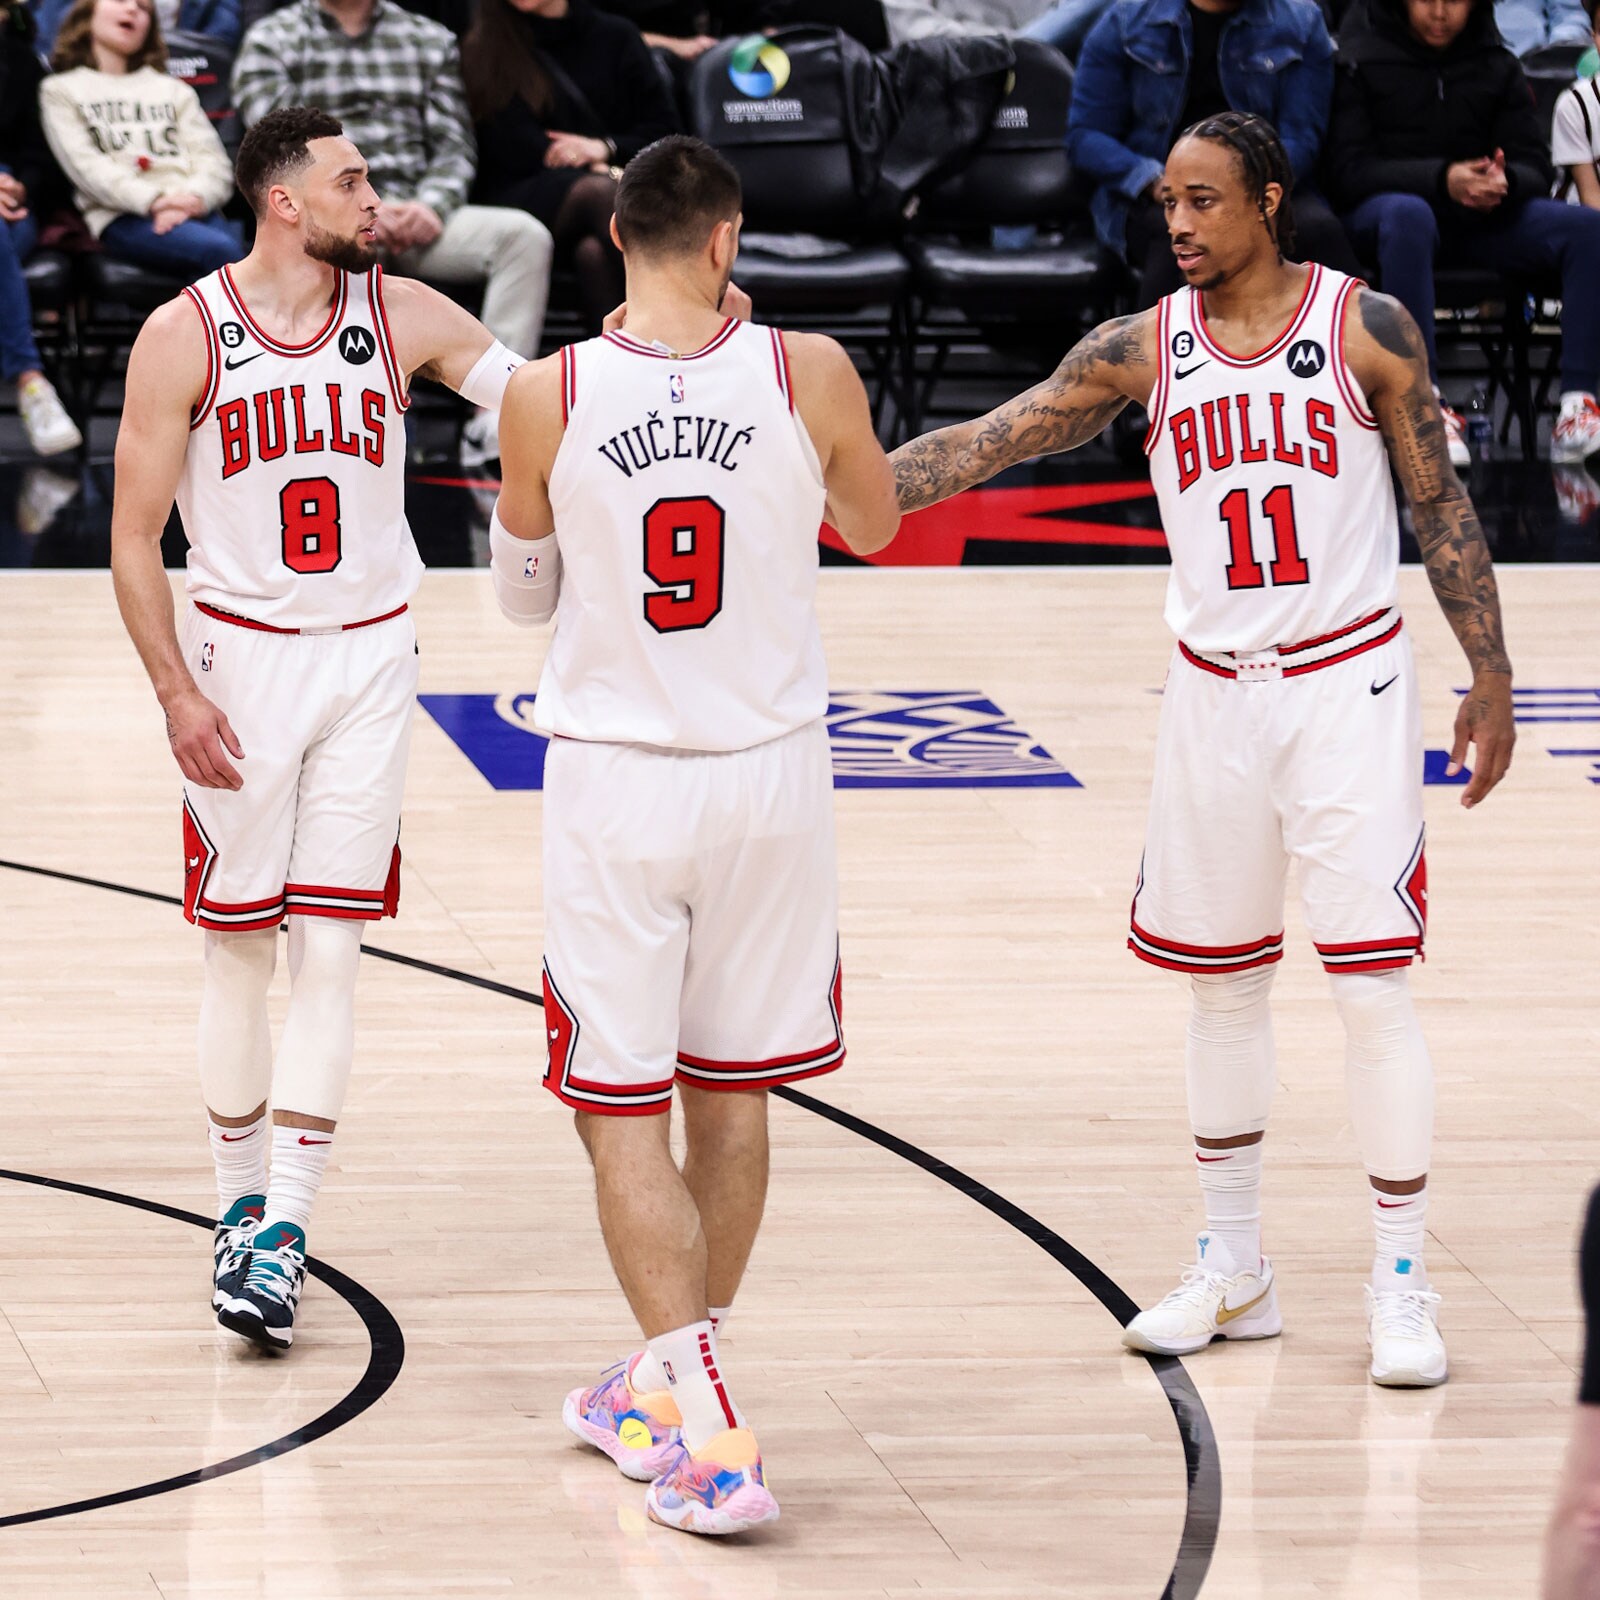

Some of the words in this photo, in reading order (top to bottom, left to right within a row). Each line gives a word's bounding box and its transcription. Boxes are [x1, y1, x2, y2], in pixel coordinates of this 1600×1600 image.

[216, 383, 386, 480] BULLS
[598, 410, 756, 478] VUČEVIĆ
[1169, 393, 1338, 494] BULLS
[279, 476, 342, 574] 8
[643, 495, 725, 634] 9
[1219, 484, 1310, 591] 11
